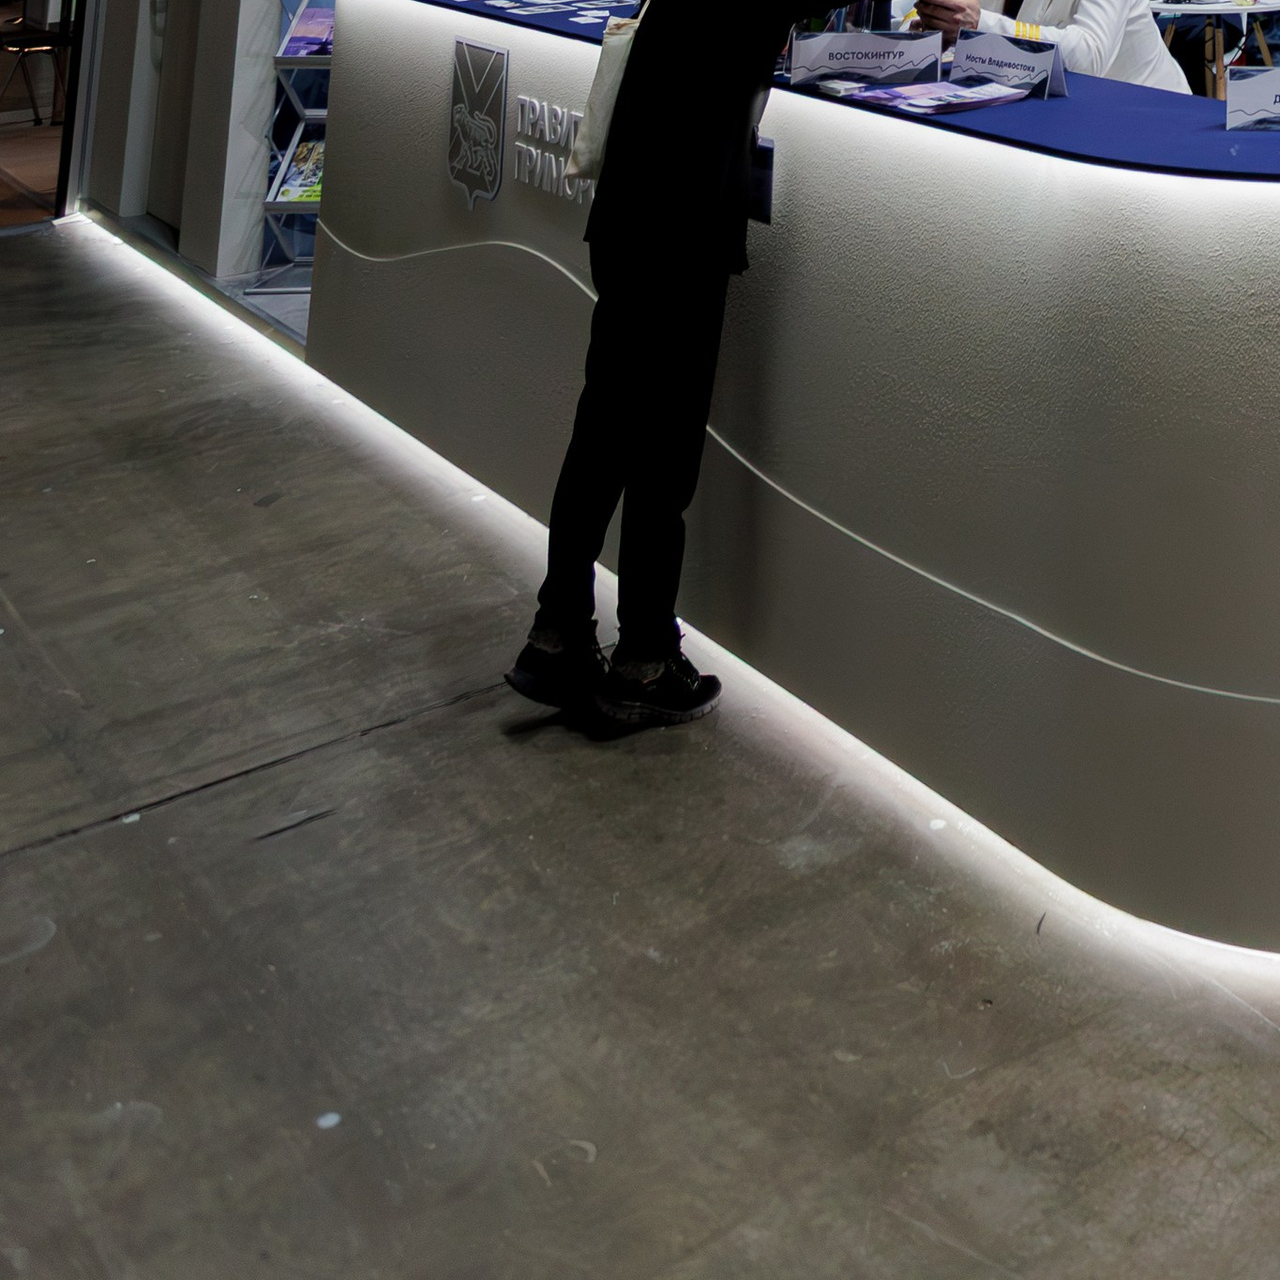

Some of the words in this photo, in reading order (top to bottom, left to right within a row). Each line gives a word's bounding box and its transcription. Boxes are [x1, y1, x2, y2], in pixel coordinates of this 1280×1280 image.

[828, 51, 905, 61] ВОСТОКИНТУР
[965, 53, 987, 65] Мосты
[988, 56, 1036, 73] Владивостока
